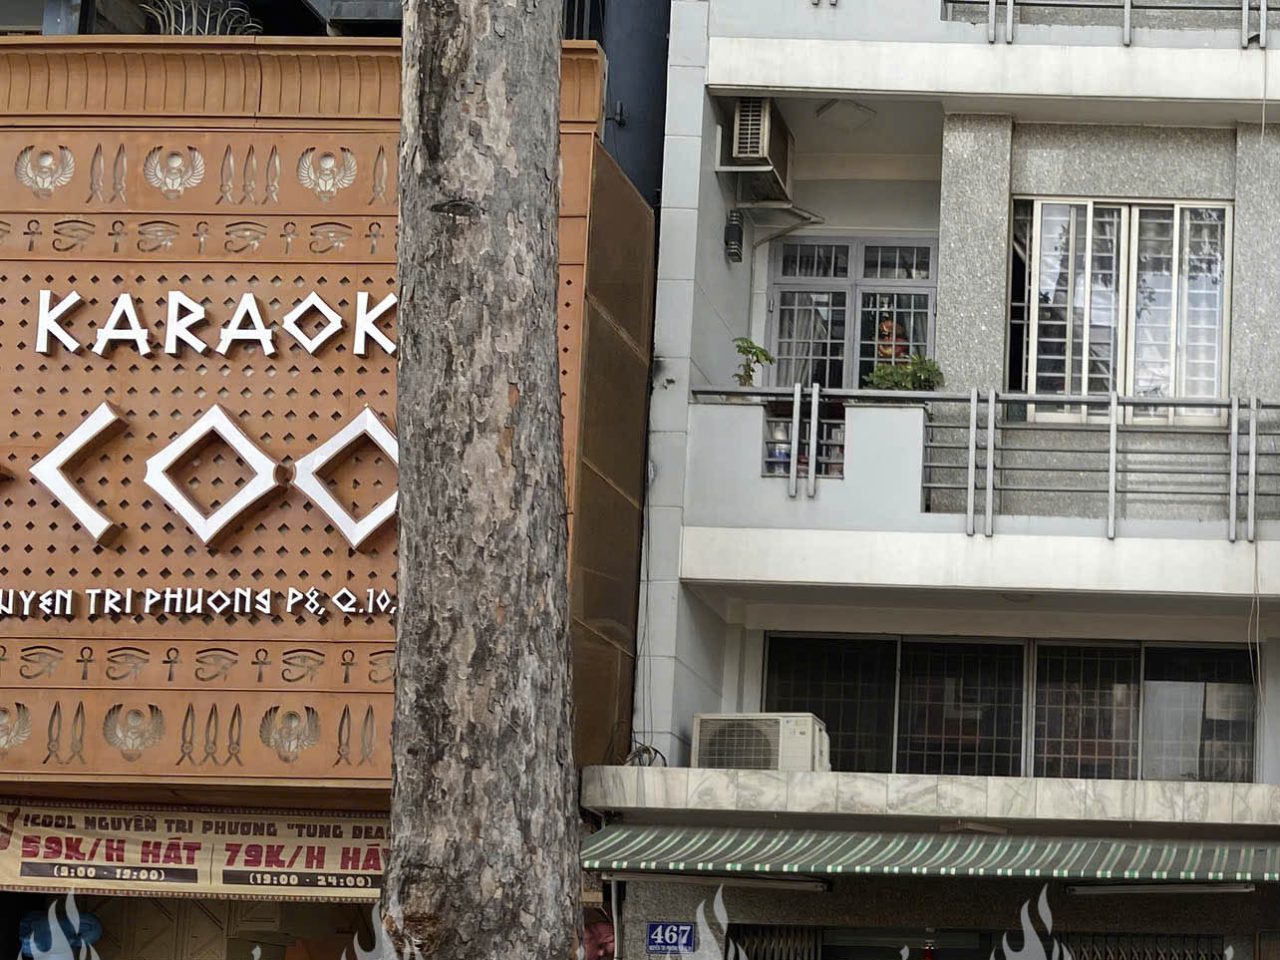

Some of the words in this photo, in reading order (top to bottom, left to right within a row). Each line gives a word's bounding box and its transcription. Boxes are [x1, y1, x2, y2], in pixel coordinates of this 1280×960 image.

[85, 588, 132, 614] TRI
[144, 587, 271, 614] PHUONG
[84, 814, 157, 833] NGUYỄN
[164, 819, 193, 834] TRI
[201, 820, 278, 837] PHƯƠNG
[21, 835, 125, 863] 59K/H
[140, 836, 201, 866] HÁT
[224, 843, 325, 870] 79K/H
[650, 925, 691, 944] 467
